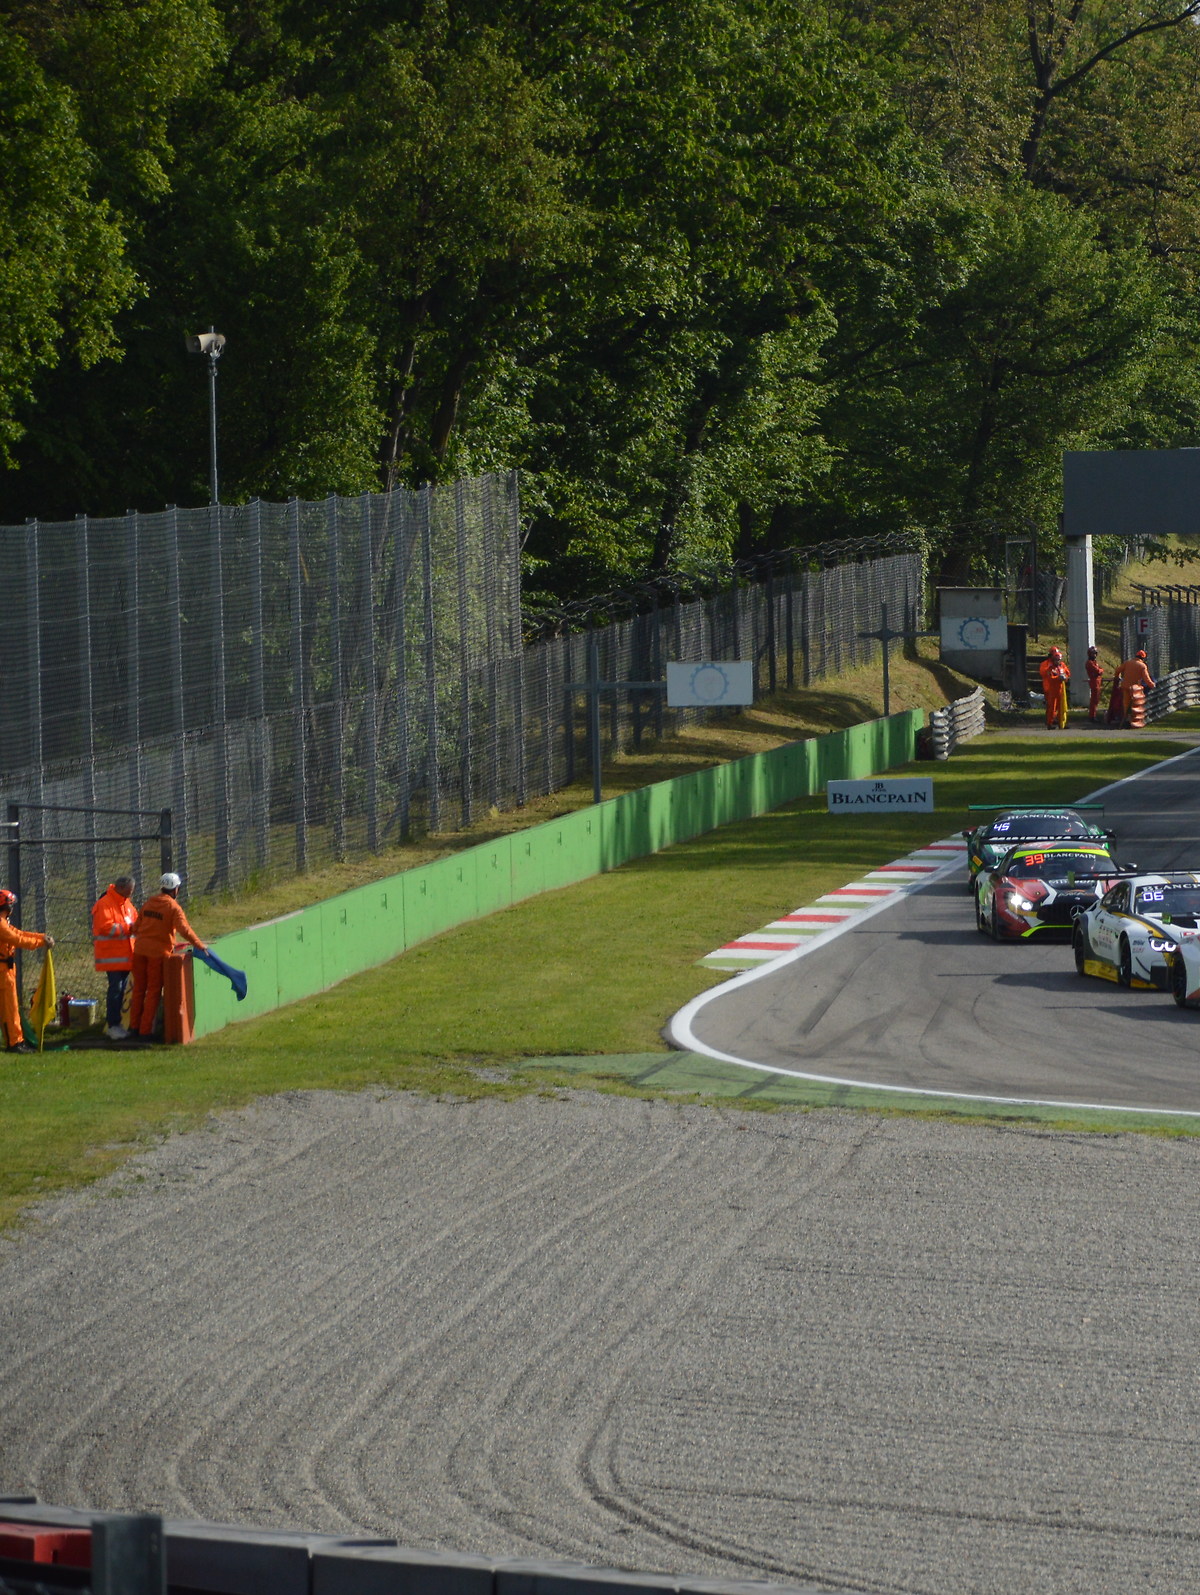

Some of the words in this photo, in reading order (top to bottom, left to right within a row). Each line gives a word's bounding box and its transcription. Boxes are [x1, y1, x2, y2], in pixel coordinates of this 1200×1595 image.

[1140, 618, 1149, 633] F
[832, 792, 927, 804] BLANCPAIN
[993, 822, 1011, 832] 45
[1025, 853, 1045, 866] 39
[1142, 890, 1165, 902] 06
